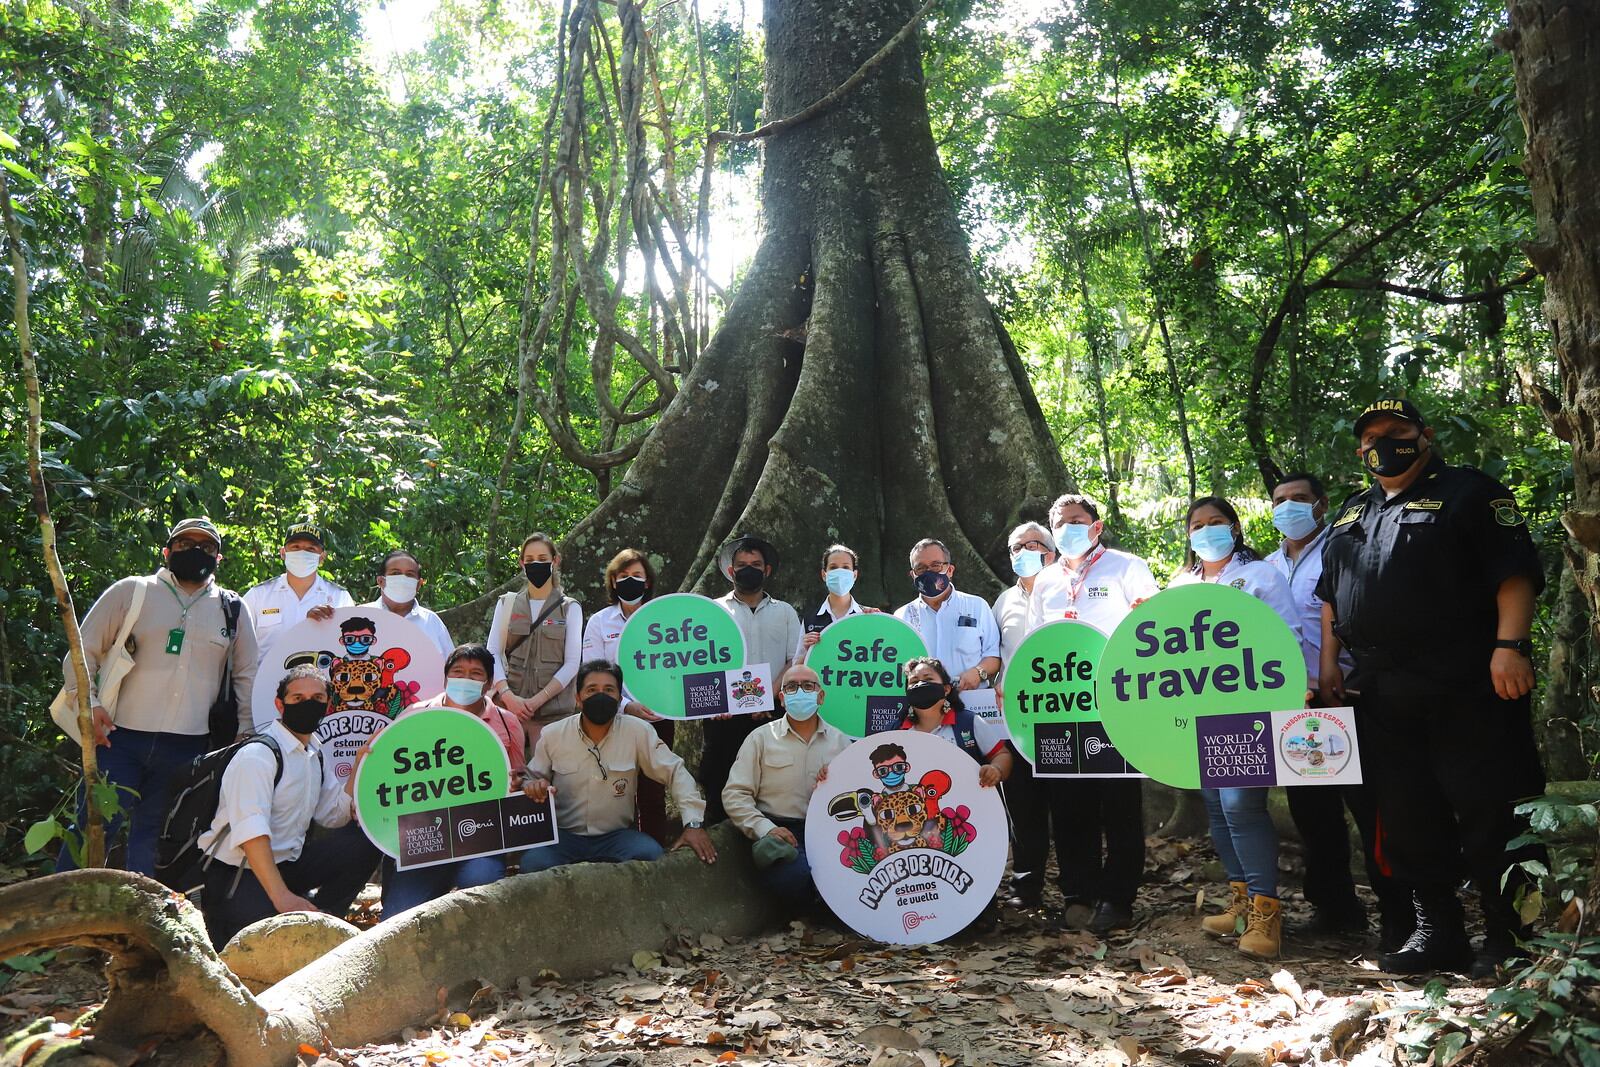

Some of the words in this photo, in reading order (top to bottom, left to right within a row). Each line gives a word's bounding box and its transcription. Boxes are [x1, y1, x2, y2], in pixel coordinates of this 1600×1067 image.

[1361, 400, 1403, 415] LICIA
[290, 525, 320, 539] POLICIA
[647, 618, 708, 645] Safe
[1135, 609, 1240, 657] Safe
[633, 640, 731, 670] travels
[837, 638, 898, 662] Safe
[1031, 652, 1093, 683] Safe
[1111, 648, 1286, 701] travels
[820, 663, 905, 688] travel
[690, 690, 715, 698] TRAVEL
[690, 695, 720, 703] TOURISM
[1017, 680, 1099, 713] trave
[314, 716, 351, 744] DRE
[352, 715, 374, 734] DE
[1174, 716, 1188, 729] by
[1281, 712, 1312, 733] TAMBOPATA
[1323, 712, 1346, 730] ESPERA
[334, 738, 367, 748] estam
[1204, 733, 1254, 745] WORLD
[393, 738, 465, 774] Safe
[1204, 744, 1255, 755] TRAVEL
[1256, 743, 1267, 753] &
[1205, 754, 1268, 766] TOURISM
[1207, 765, 1269, 777] COUNCIL
[376, 763, 493, 807] travels
[509, 812, 545, 827] Manu
[406, 825, 436, 836] WORLD
[406, 832, 436, 842] TRAVEL
[407, 838, 444, 849] TOURISM
[408, 845, 445, 855] COUNCIL
[859, 858, 909, 910] MADRE
[907, 854, 932, 876] DE
[931, 855, 974, 895] DIOS
[895, 881, 937, 895] estamos
[897, 897, 908, 907] de
[909, 892, 939, 904] vuelta
